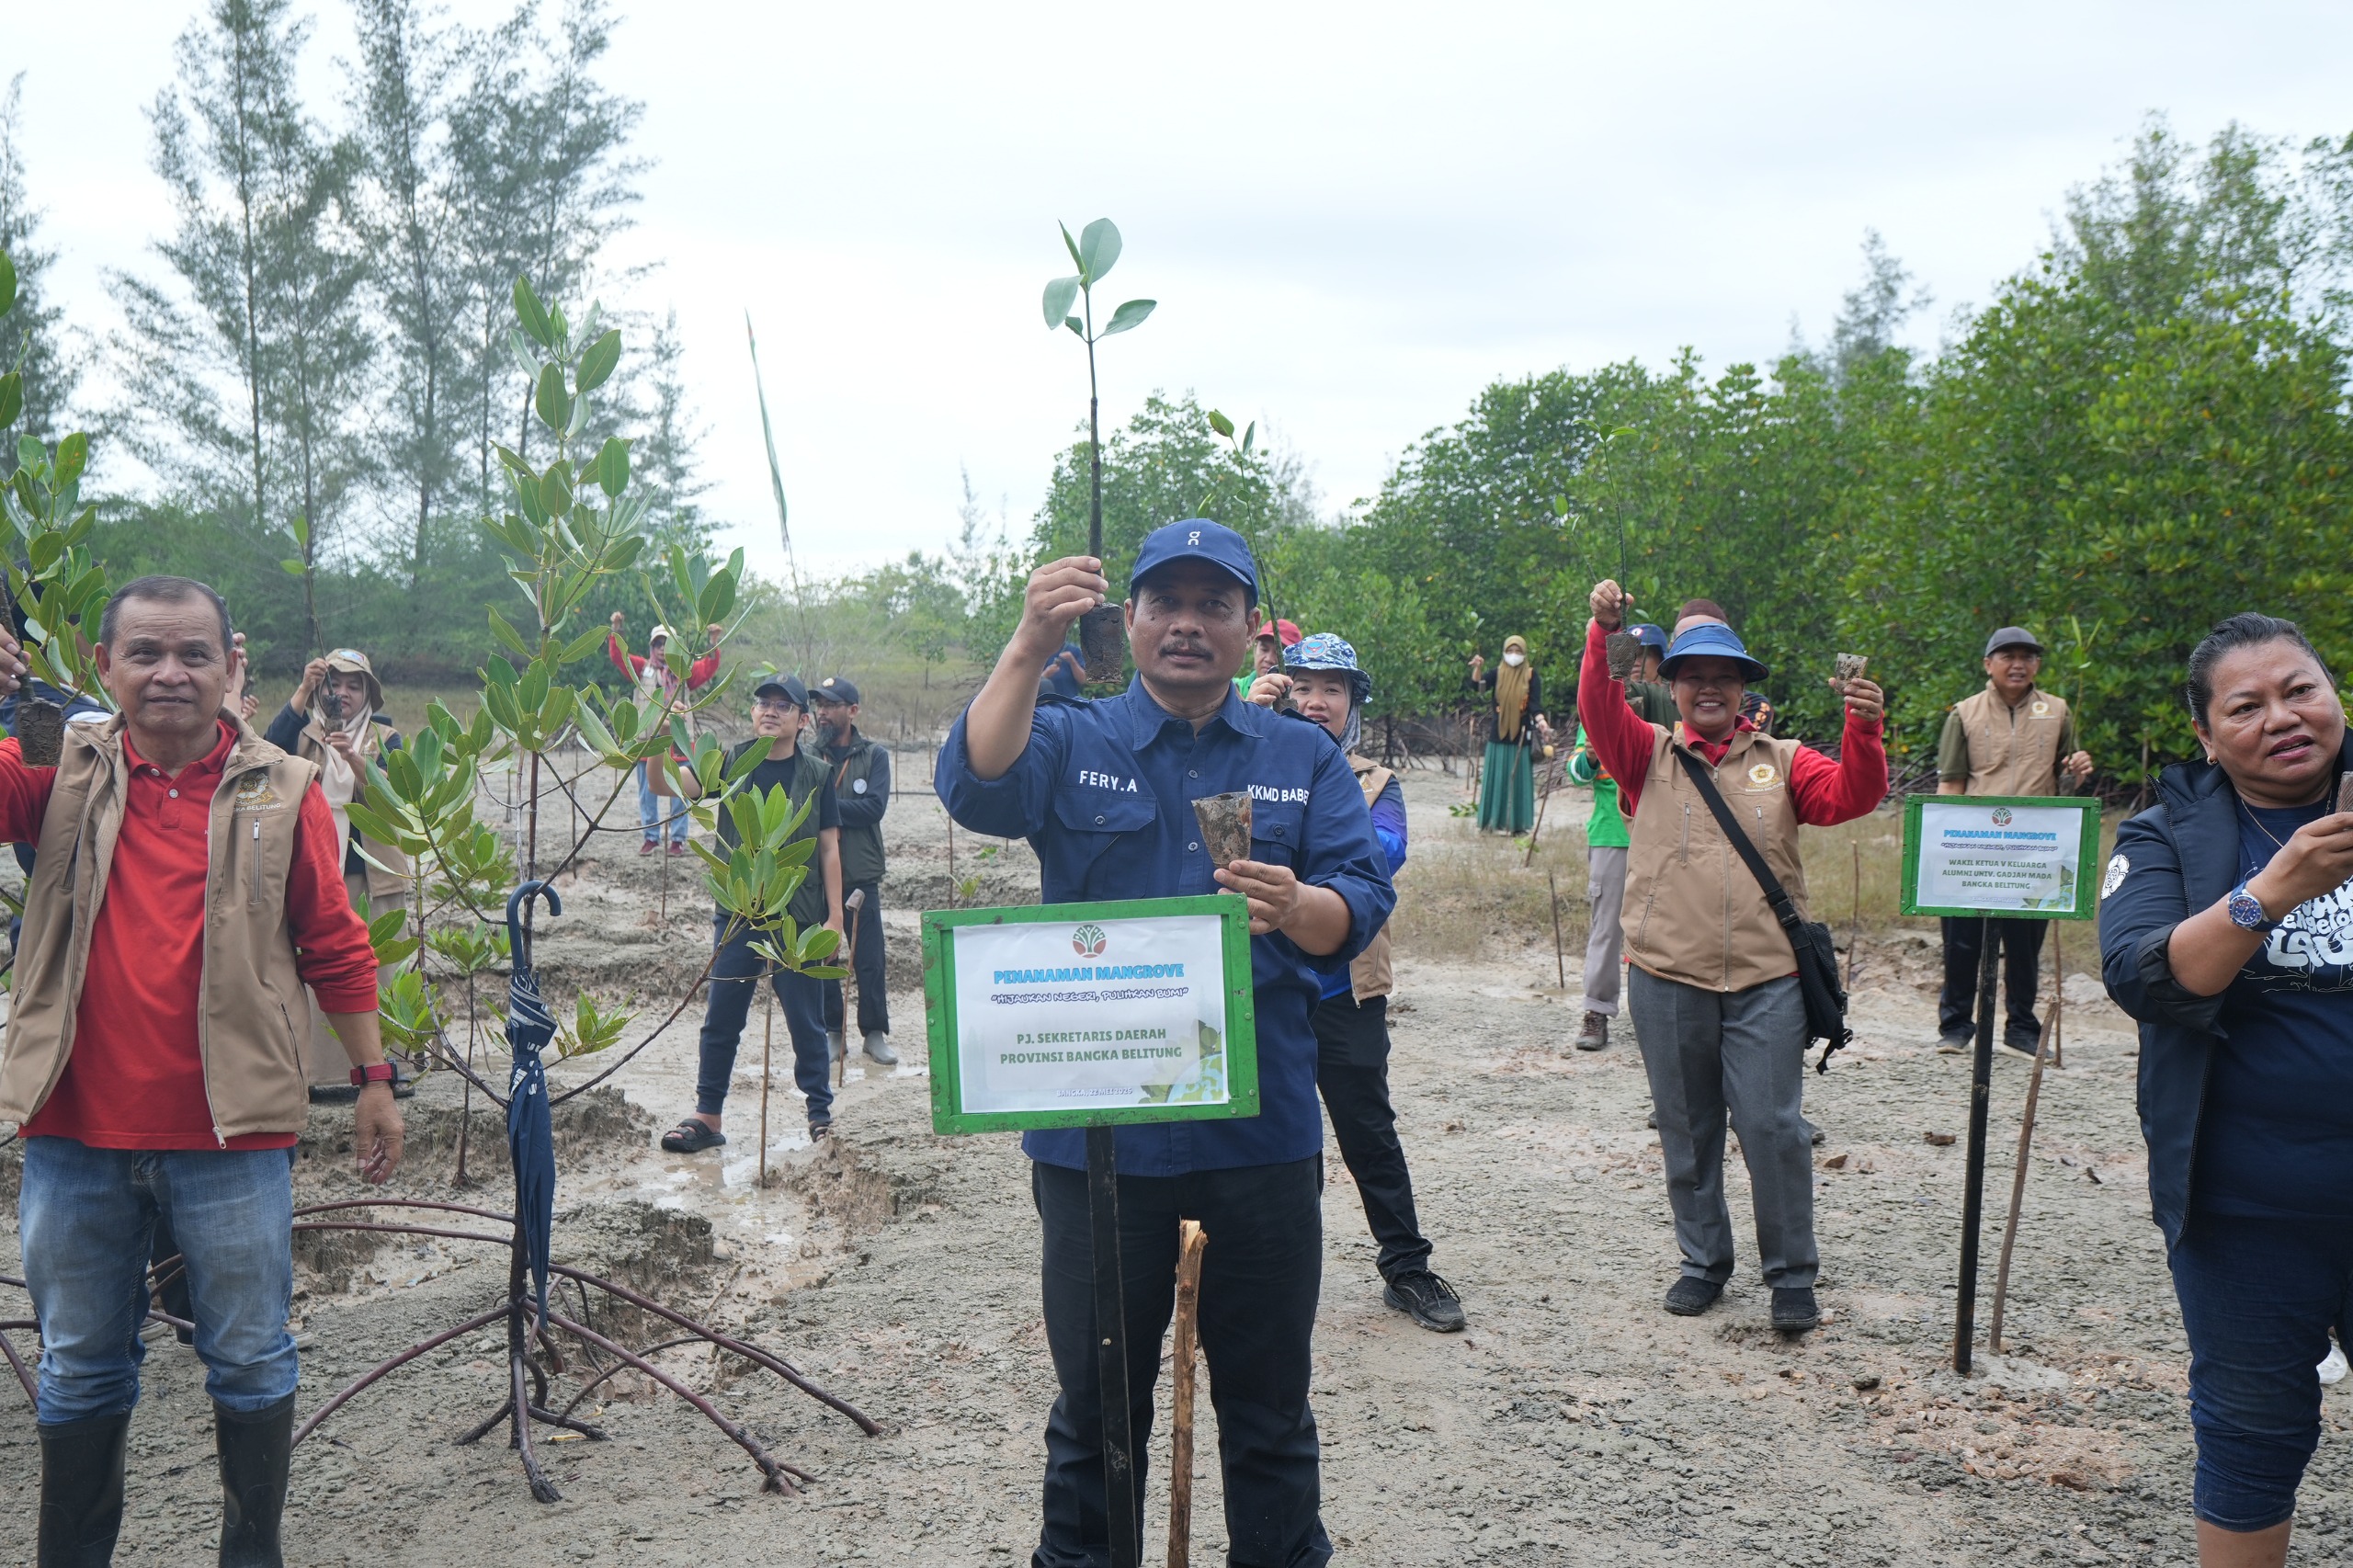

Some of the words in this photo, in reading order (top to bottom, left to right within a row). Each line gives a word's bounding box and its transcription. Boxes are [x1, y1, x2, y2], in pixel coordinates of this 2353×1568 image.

[1079, 770, 1138, 792] FERY.A
[1247, 784, 1279, 801] KKMD
[246, 802, 281, 811] BELITUNG
[1943, 829, 2002, 839] PENANAMAN
[2003, 831, 2057, 841] MANGROVE
[994, 966, 1093, 984] PENANAMAN
[1095, 963, 1185, 981] MANGROVE
[1101, 988, 1154, 1001] PULIHKAN
[1017, 1034, 1035, 1044] PJ.
[1038, 1030, 1112, 1044] SEKRETARIS
[1115, 1028, 1166, 1041] DAERAH
[1000, 1051, 1063, 1064] PROVINSI
[1066, 1049, 1119, 1062] BANGKA
[1121, 1047, 1182, 1060] BELITUNG
